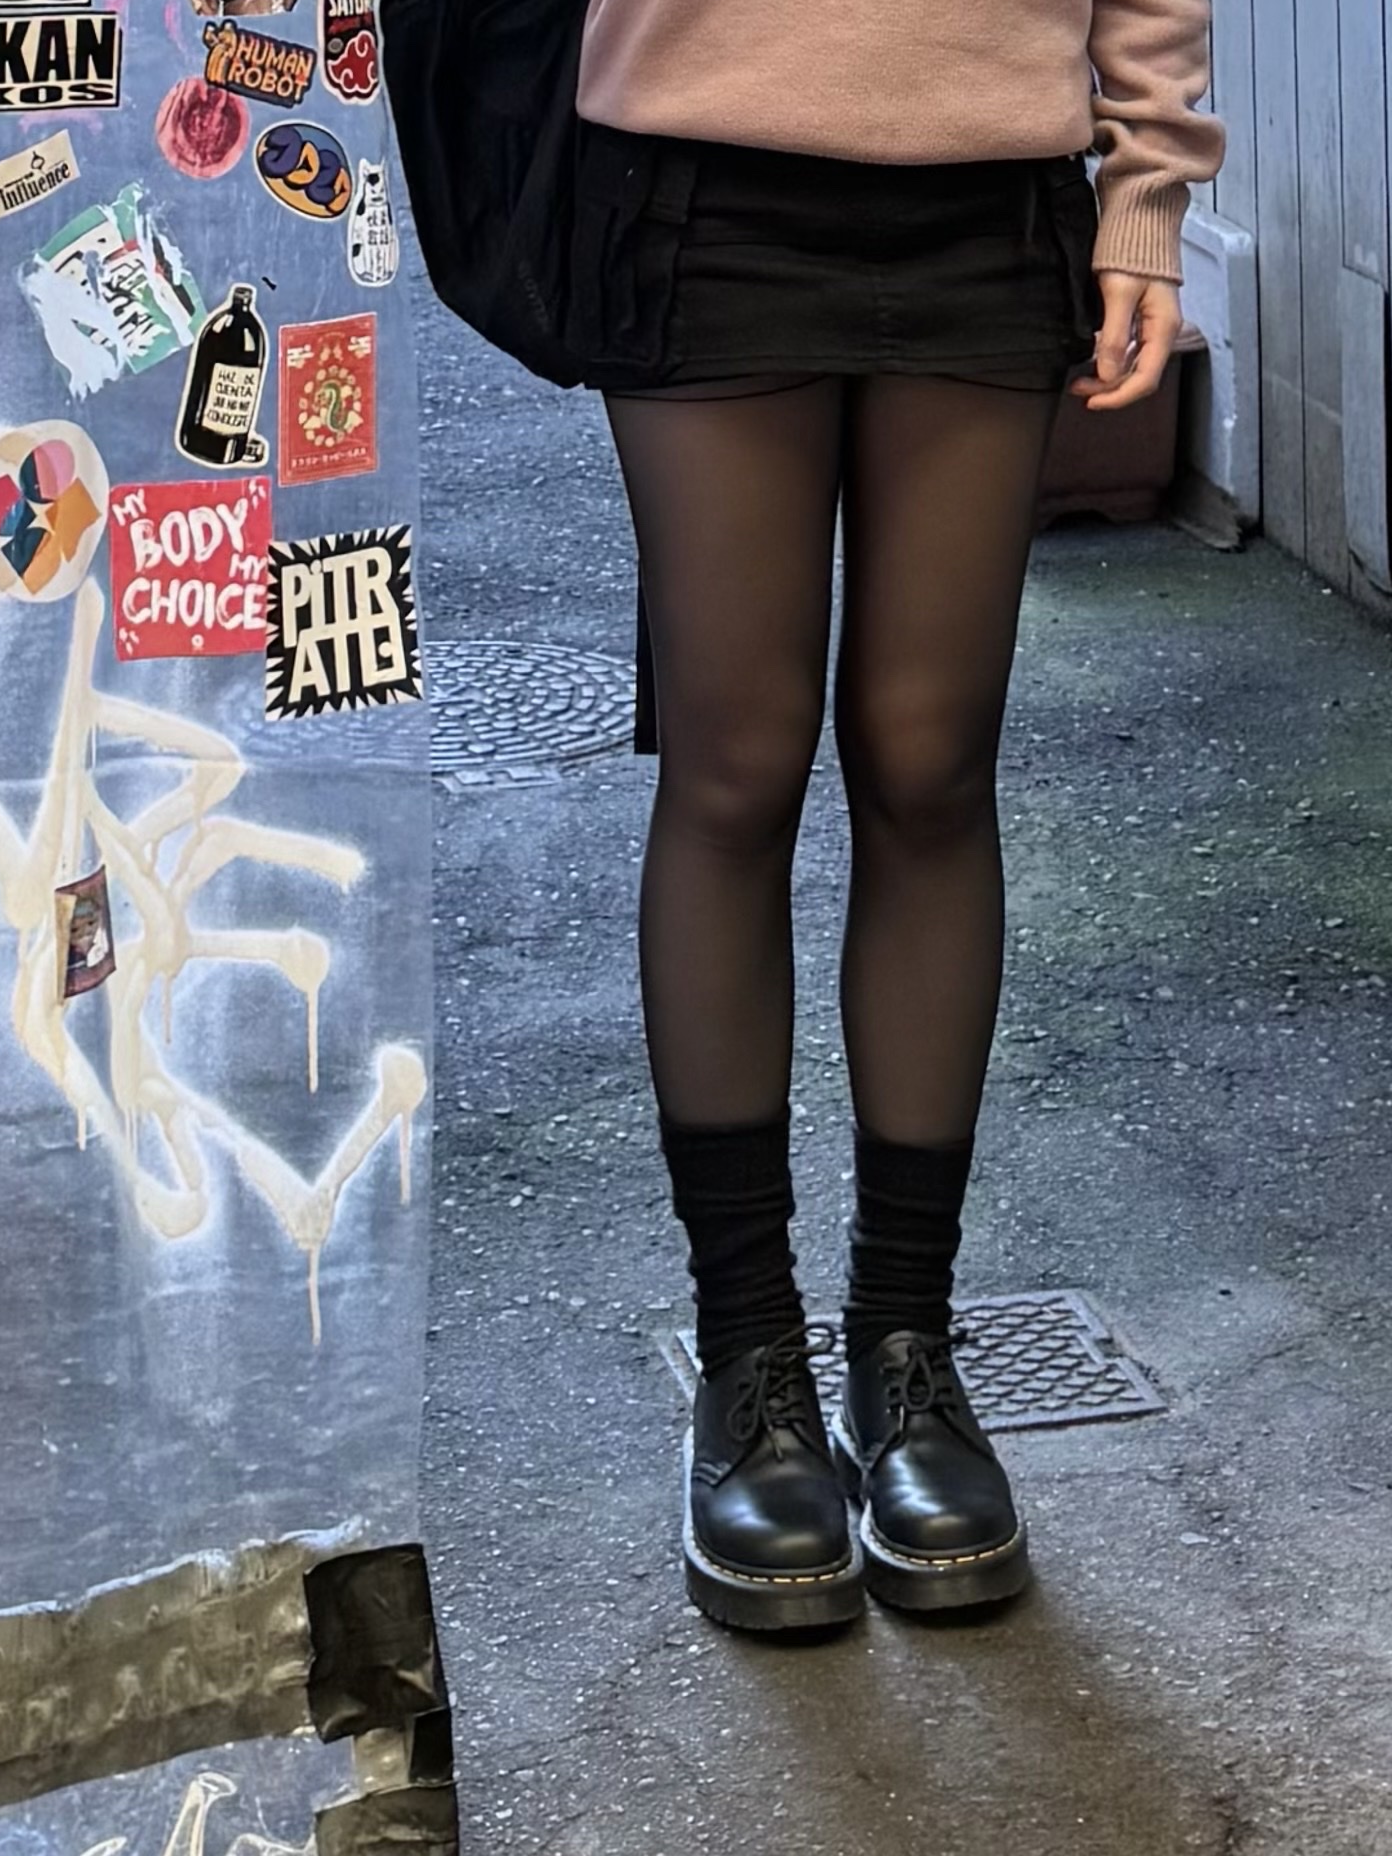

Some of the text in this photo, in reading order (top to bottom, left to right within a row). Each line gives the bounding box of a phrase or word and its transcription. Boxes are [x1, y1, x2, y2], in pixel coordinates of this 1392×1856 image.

[238, 35, 313, 75] HUMAN
[228, 62, 309, 101] ROBOT
[113, 488, 147, 526] MY
[129, 500, 252, 570] BODY
[228, 553, 267, 579] MY
[122, 580, 267, 630] CHOICE
